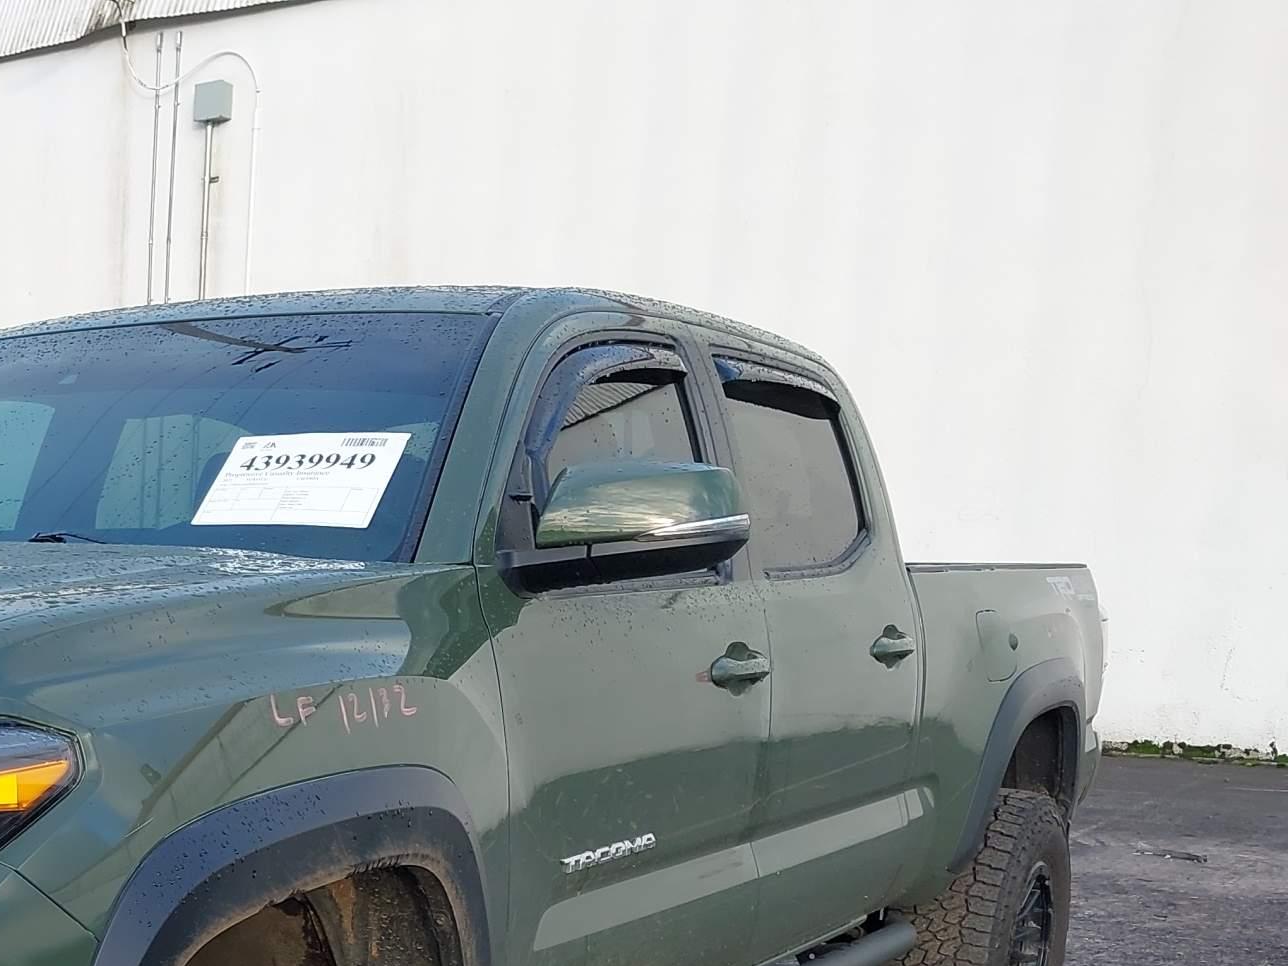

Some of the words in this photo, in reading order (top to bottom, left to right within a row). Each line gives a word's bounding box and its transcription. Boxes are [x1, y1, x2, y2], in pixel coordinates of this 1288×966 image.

[240, 453, 376, 472] 43939949
[270, 693, 318, 727] LF
[560, 832, 657, 874] TACOMA
